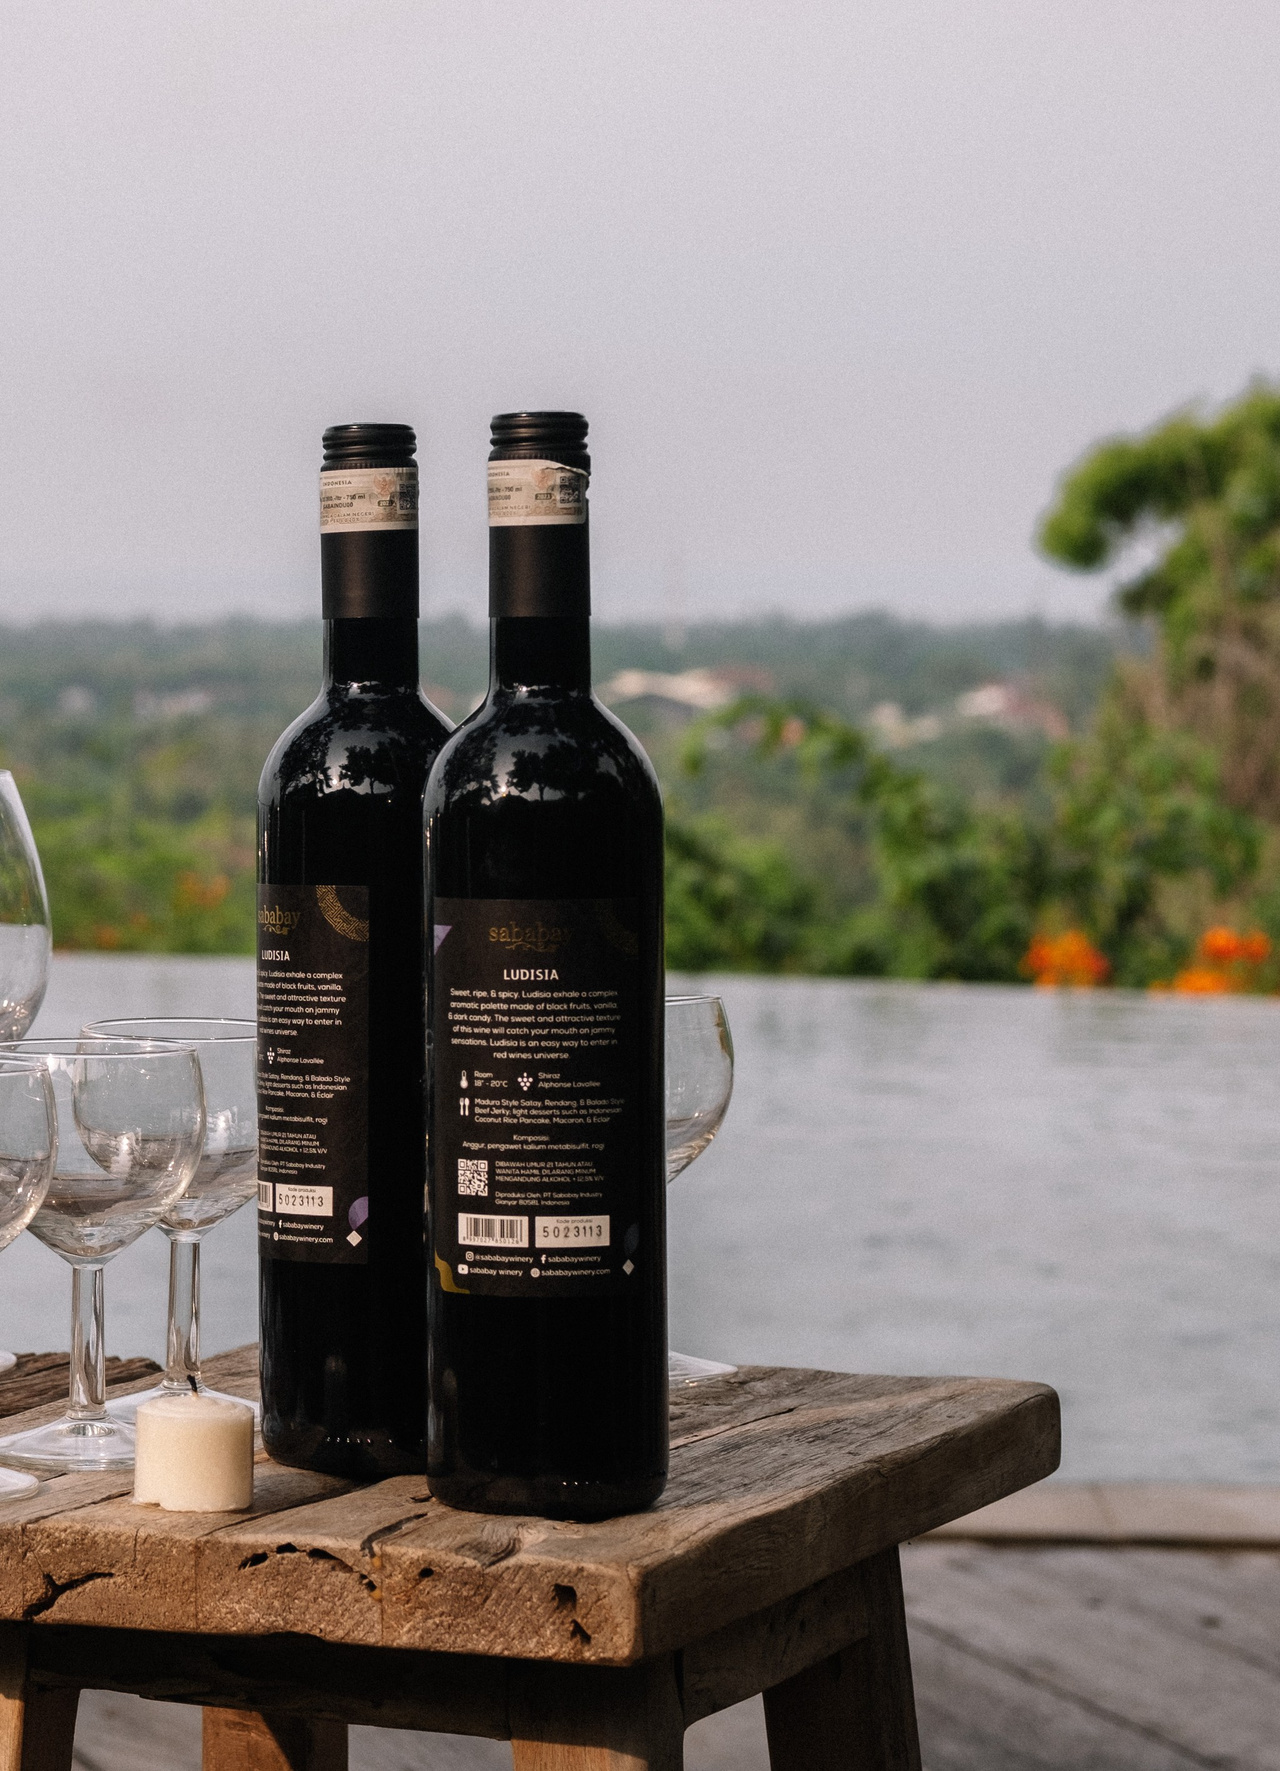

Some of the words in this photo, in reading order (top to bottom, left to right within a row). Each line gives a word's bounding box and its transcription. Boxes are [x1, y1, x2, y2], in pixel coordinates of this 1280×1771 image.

[262, 950, 290, 961] LUDISIA
[503, 968, 560, 981] LUDISIA
[498, 991, 520, 999] spicy.
[315, 1006, 340, 1015] jammy
[480, 1002, 509, 1011] palette
[469, 1014, 492, 1023] candy.
[460, 1025, 472, 1033] this
[473, 1026, 491, 1034] wine
[590, 1026, 616, 1035] jammy
[490, 1038, 518, 1046] Ludisia
[540, 1040, 560, 1048] easy
[562, 1040, 579, 1048] way
[538, 1081, 572, 1089] Alphonse
[501, 1099, 519, 1107] Style
[520, 1099, 543, 1107] Satay,
[545, 1100, 578, 1108] Rendang,
[490, 1107, 511, 1116] Jerky,
[512, 1108, 528, 1116] light
[315, 1117, 328, 1125] ragi
[475, 1115, 502, 1123] Coconut
[487, 1142, 521, 1151] pengawet
[523, 1142, 546, 1150] kalium
[592, 1142, 605, 1151] ragi
[279, 1193, 324, 1207] 5023113
[283, 1222, 324, 1231] sababaywinery
[542, 1224, 603, 1238] 5023113
[279, 1234, 333, 1243] sababaywinery.com
[475, 1253, 534, 1264] @sababaywinery
[548, 1254, 601, 1263] sababaywinery
[470, 1268, 497, 1276] sababay
[541, 1269, 611, 1277] sababaywinery.com
